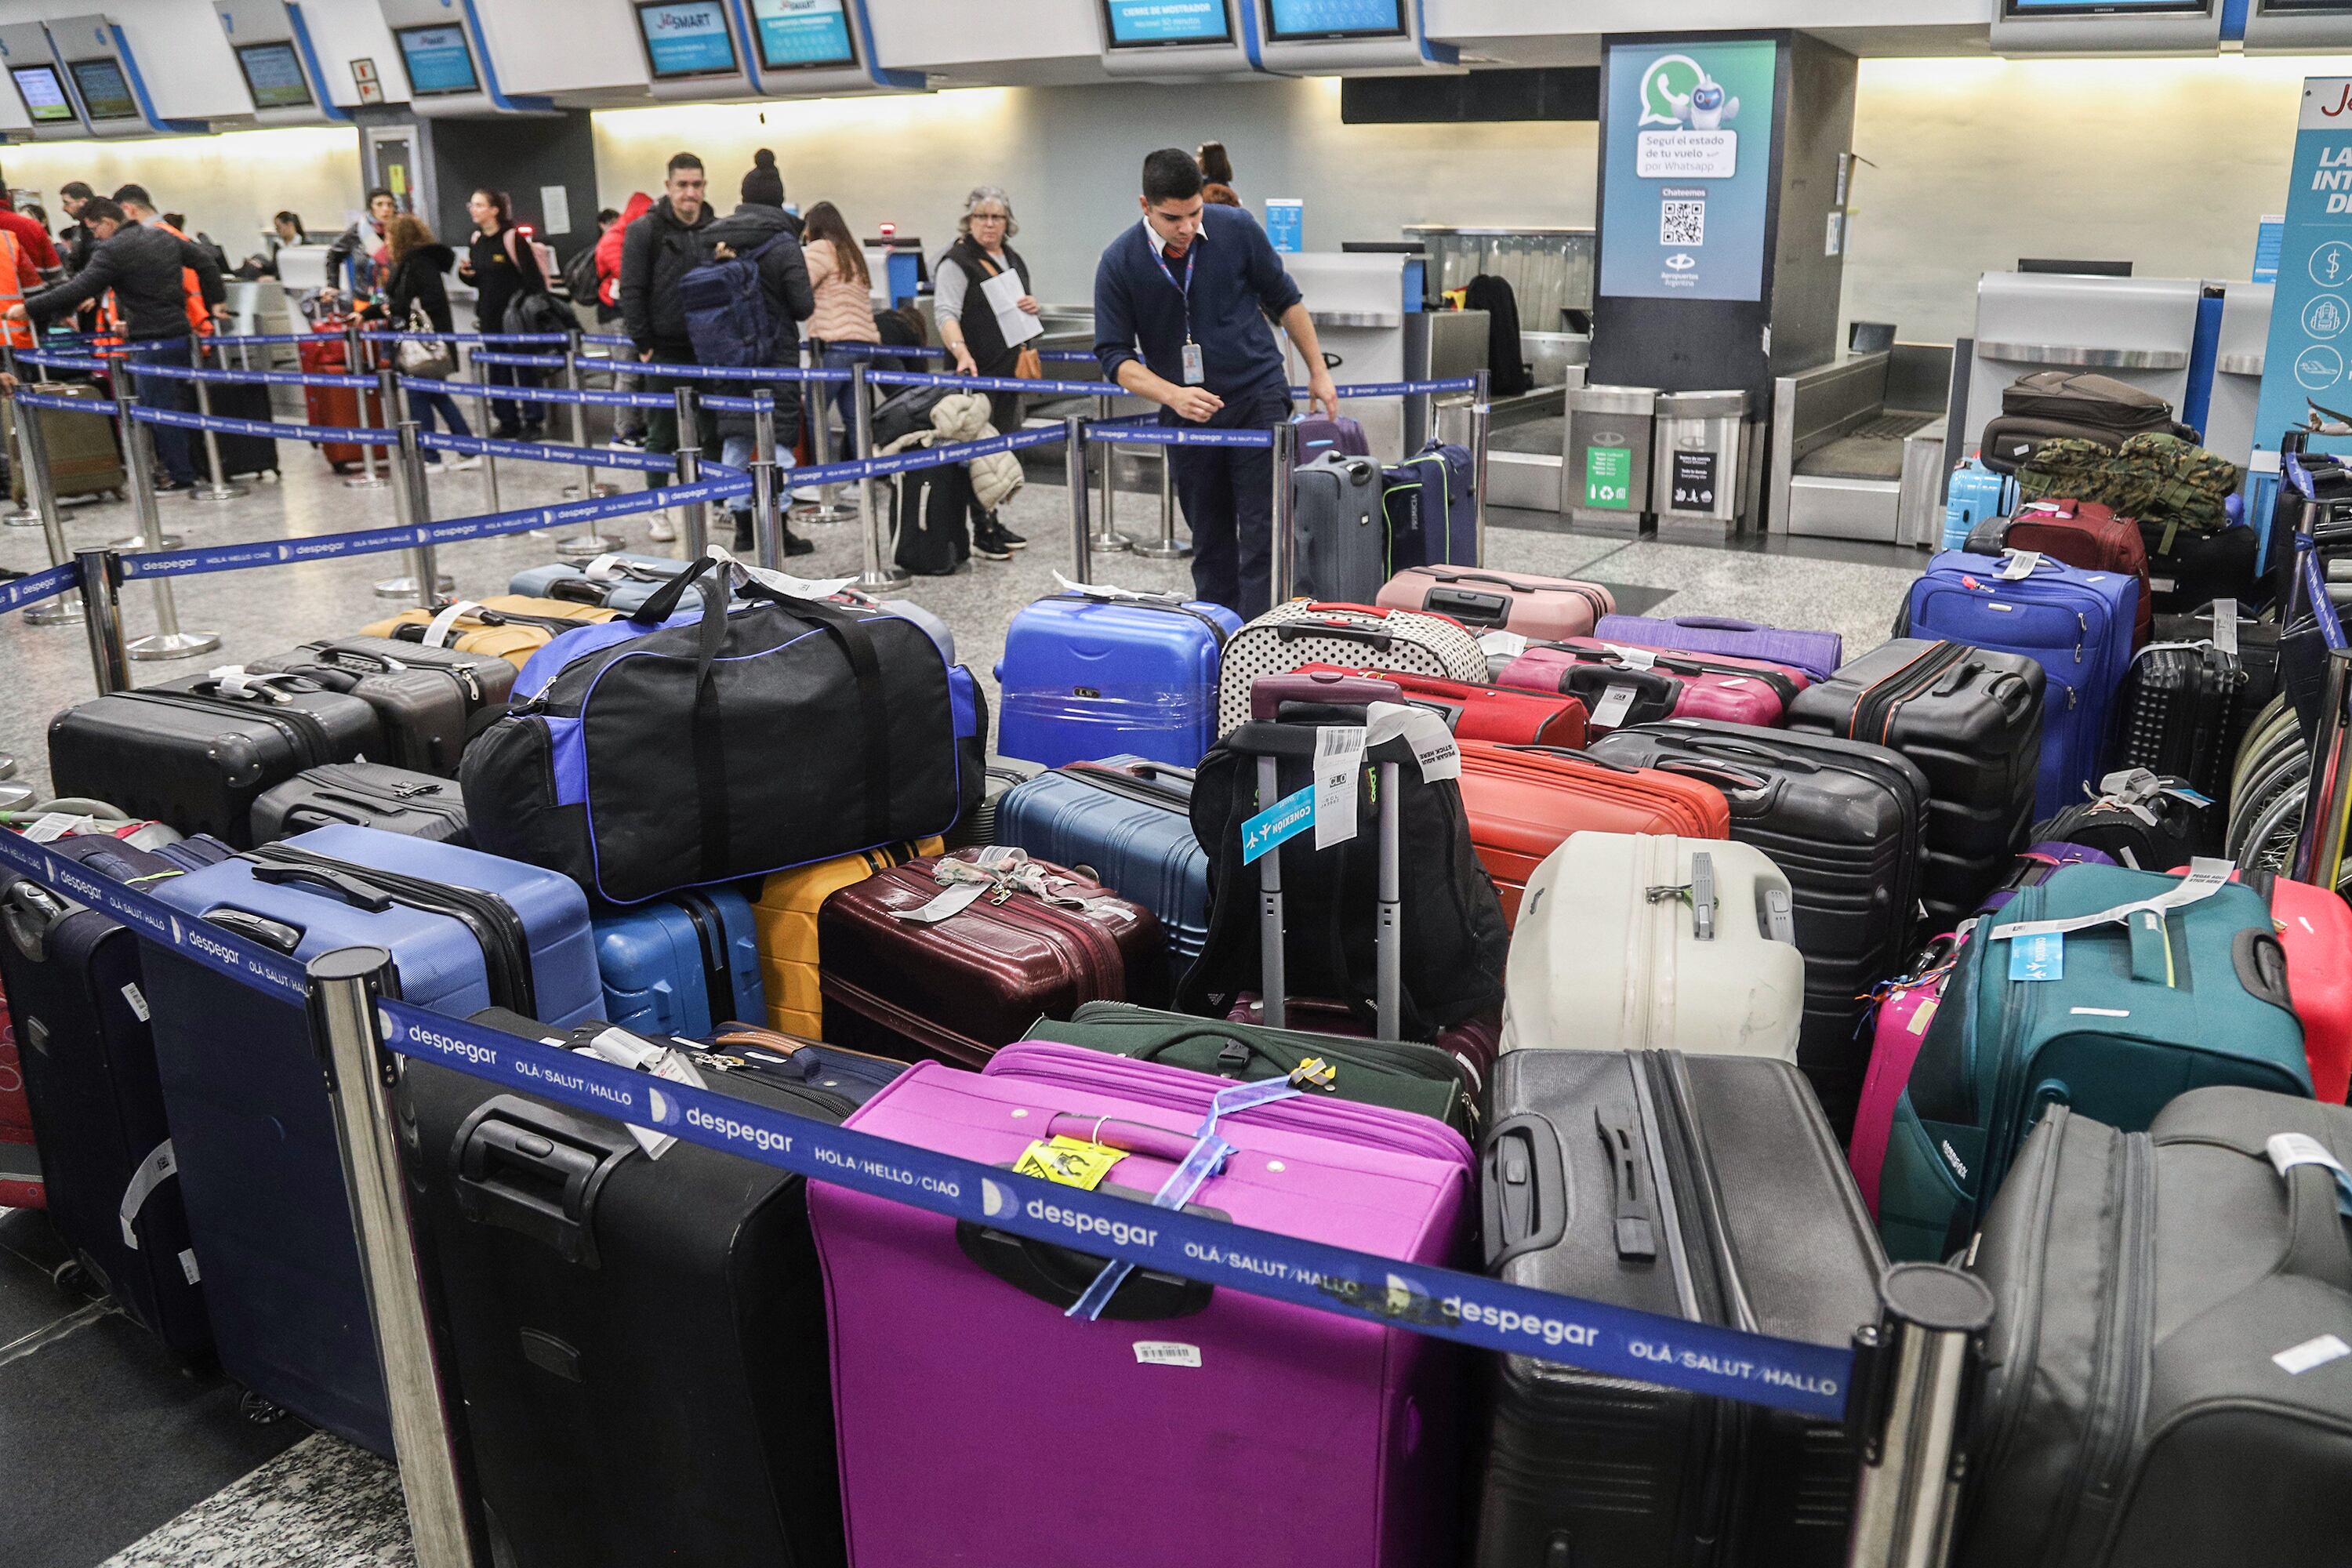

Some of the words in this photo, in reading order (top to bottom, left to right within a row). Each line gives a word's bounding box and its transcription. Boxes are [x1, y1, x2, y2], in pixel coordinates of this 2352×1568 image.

[1677, 136, 1686, 145] el
[1690, 136, 1724, 145] estado
[1674, 149, 1703, 158] vuelo
[1645, 162, 1661, 172] por
[1664, 162, 1715, 172] Whatsapp
[1662, 187, 1706, 197] Chateemos
[142, 558, 197, 570] despegar
[23, 578, 56, 594] despegar
[1419, 751, 1434, 760] HERE
[1435, 745, 1453, 755] STICK
[1436, 750, 1456, 760] PEGAR
[1330, 773, 1347, 786] CLO
[1272, 804, 1312, 834] CONEXIÓN
[60, 869, 103, 902] despegar
[188, 931, 239, 966] despegar
[408, 1025, 497, 1065] despegar
[686, 1107, 793, 1153] despegar
[1026, 1198, 1159, 1248] despegar
[1441, 1295, 1599, 1348] despegar
